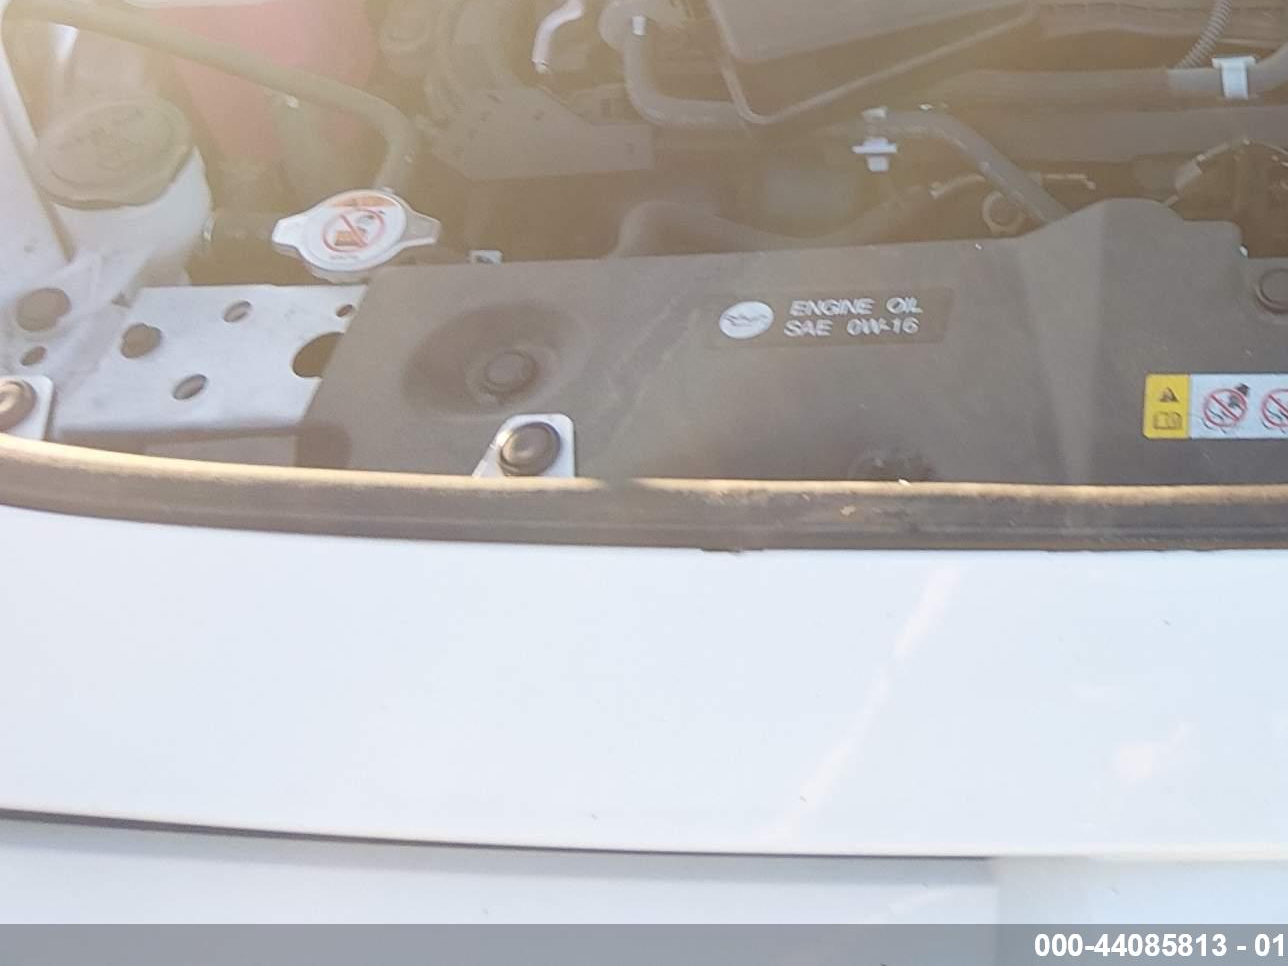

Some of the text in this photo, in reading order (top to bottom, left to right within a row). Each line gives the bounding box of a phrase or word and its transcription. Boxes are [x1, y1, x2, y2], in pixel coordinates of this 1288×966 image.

[789, 295, 923, 316] ENGINE OIL
[783, 316, 921, 337] SAE 0W-16
